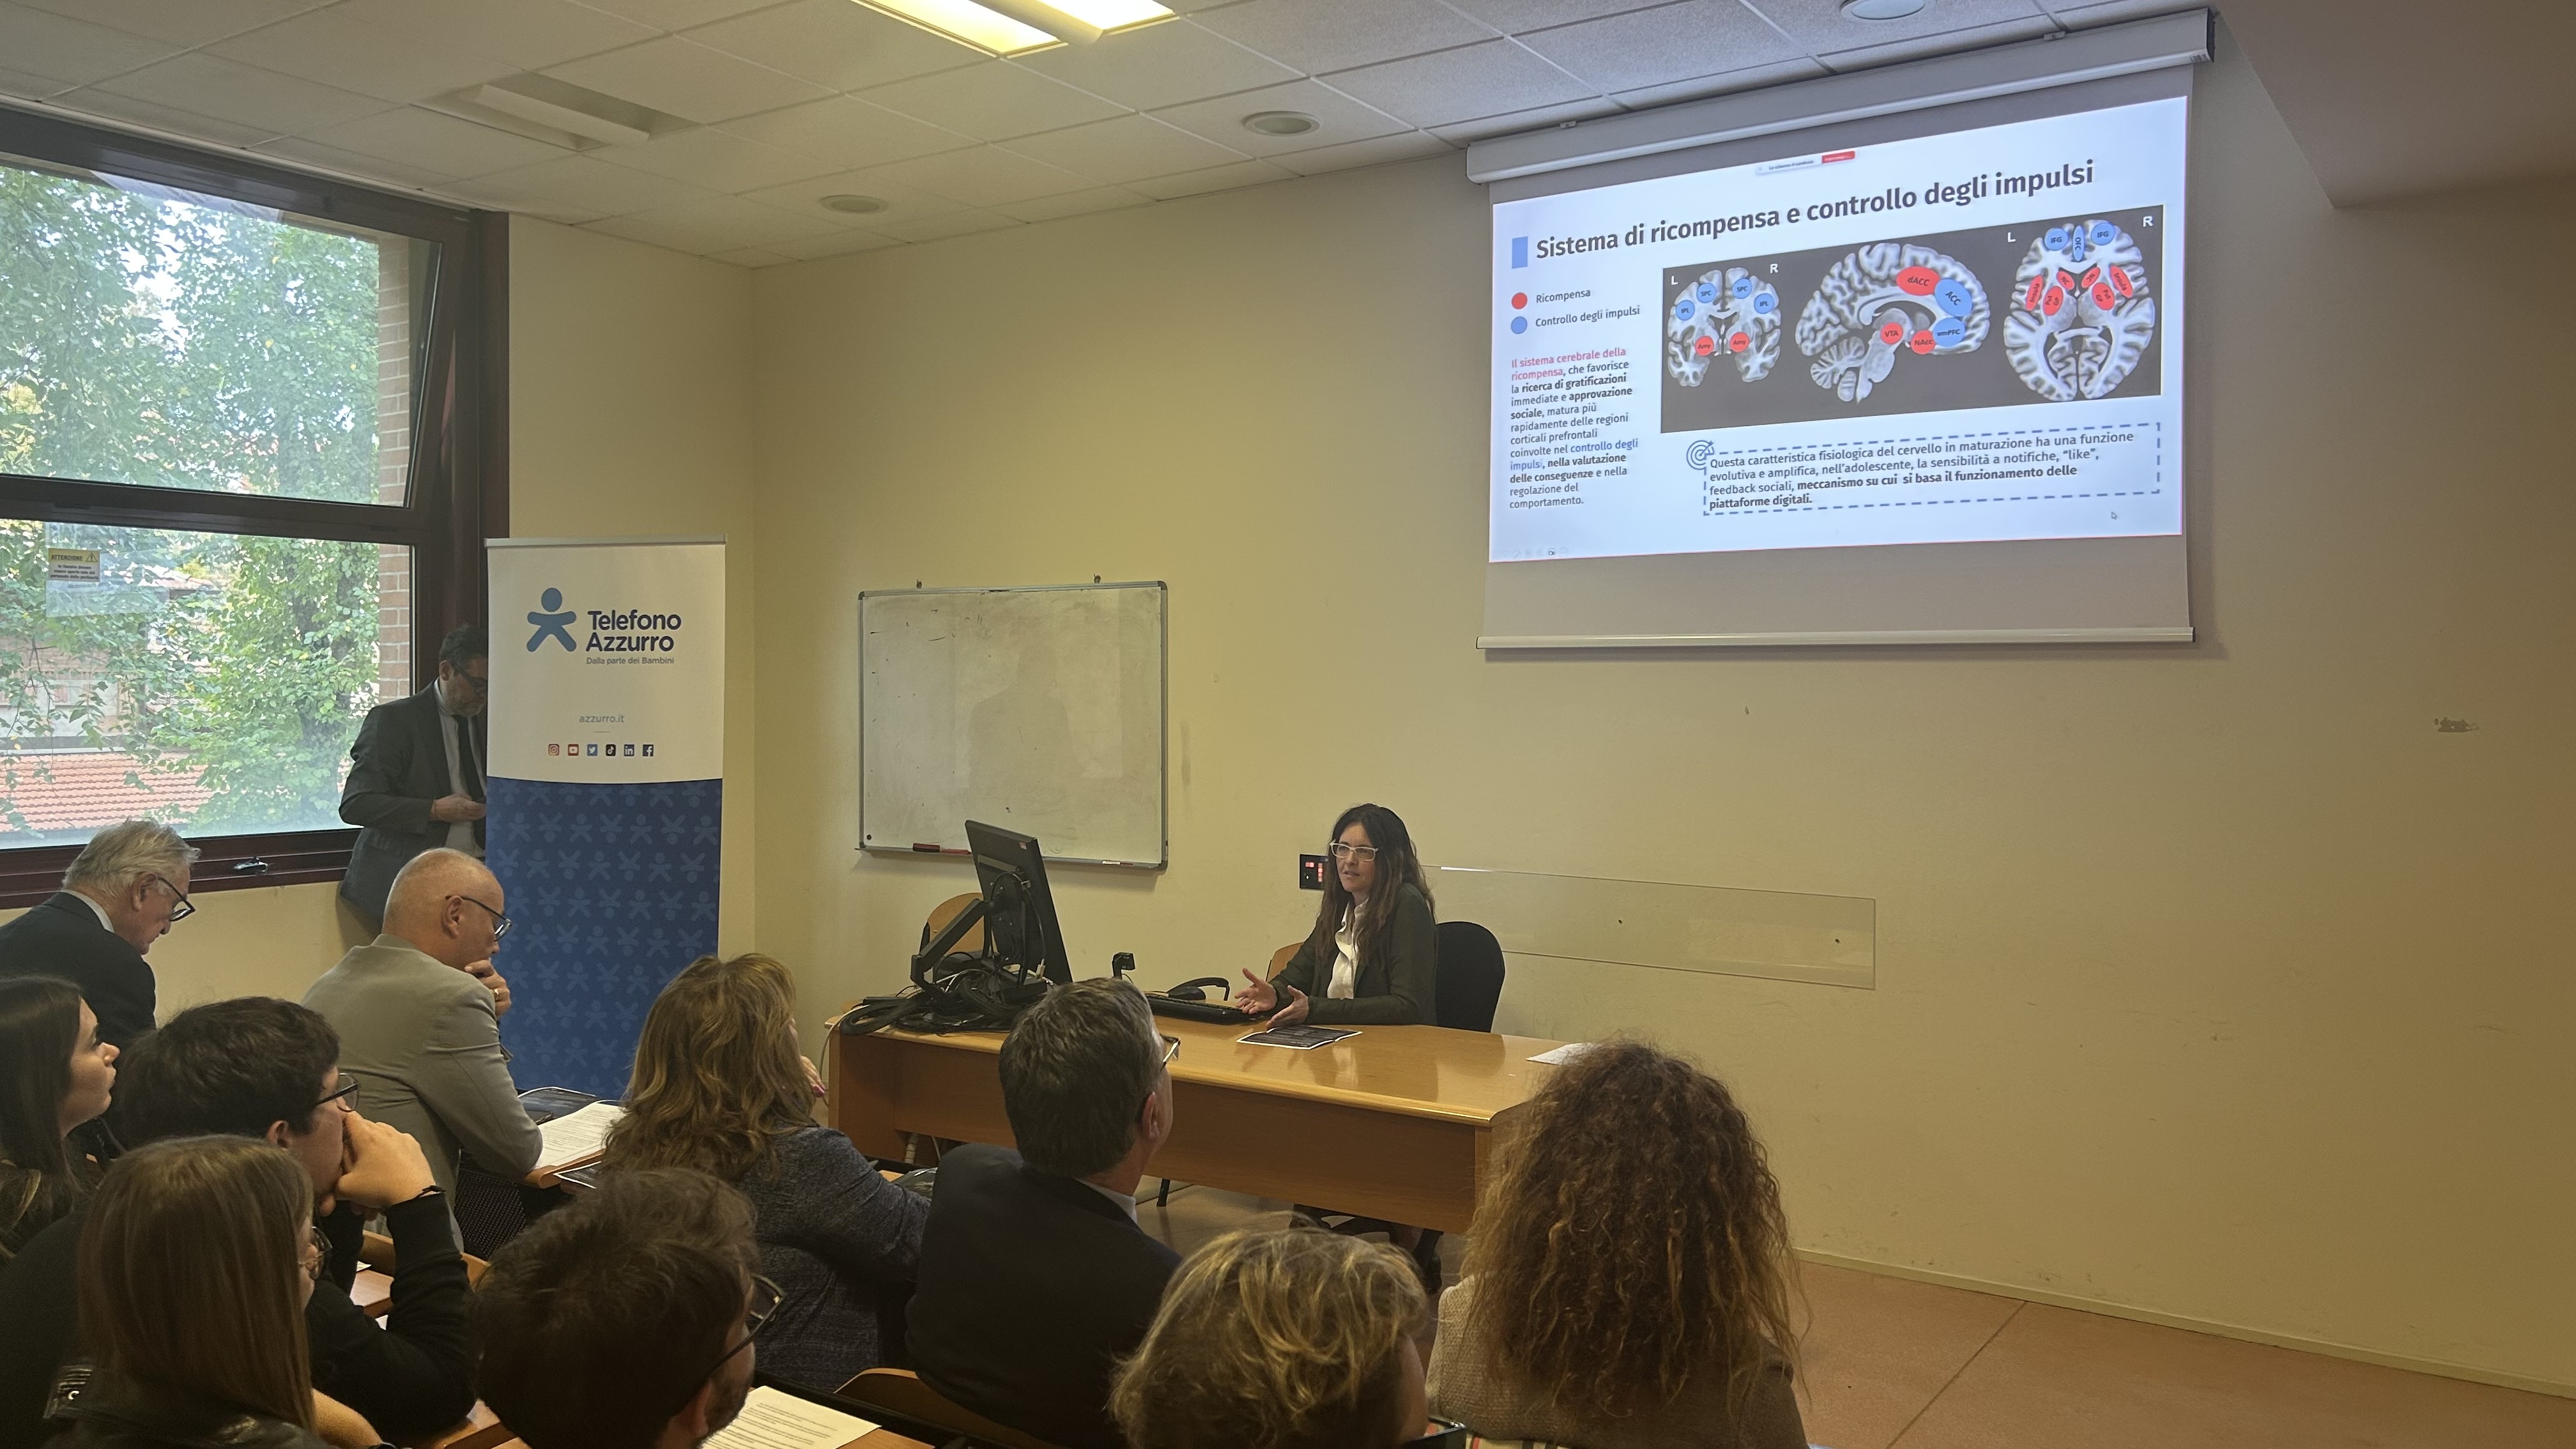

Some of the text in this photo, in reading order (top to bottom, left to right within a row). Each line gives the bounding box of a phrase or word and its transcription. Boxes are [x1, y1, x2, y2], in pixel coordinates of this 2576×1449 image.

[1537, 159, 2094, 259] Sistema di ricompensa e controllo degli impulsi
[2143, 216, 2153, 227] R
[2007, 232, 2016, 243] L
[1770, 263, 1779, 273] R
[1671, 276, 1678, 285] L
[1908, 277, 1929, 286] dACC
[1536, 288, 1591, 304] Ricompensa
[1945, 291, 1961, 306] ACC
[1535, 305, 1640, 328] Controllo degli impulsi
[1520, 355, 1554, 367] sistema
[1557, 351, 1600, 362] cerebrale
[1603, 348, 1626, 357] della
[1512, 361, 1629, 381] ricompensa, che favorisce
[1512, 372, 1626, 394] la ricerca di gratificazioni
[1511, 394, 1559, 406] immediate
[1569, 387, 1632, 402] approvazione
[1511, 403, 1597, 419] sociale, matura più
[1511, 413, 1629, 433] rapidamente delle regioni
[1511, 429, 1597, 445] corticali prefrontali
[1510, 438, 1638, 457] coinvolte nel controllo degli
[1710, 433, 2134, 468] Questa caratteristica fisiologica del cervello in maturazione ha una funzione
[1510, 453, 1626, 471] impulsi, nella valutazione
[1710, 470, 1756, 482] evolutiva
[1768, 466, 1818, 479] amplifica,
[1917, 459, 1927, 468] la
[1931, 454, 1989, 468] sensibilità
[1993, 456, 2000, 464] a
[2004, 451, 2059, 464] notifiche,
[1510, 473, 1532, 483] delle
[1535, 470, 1593, 482] conseguenze
[1604, 466, 1627, 476] nella
[1710, 465, 2077, 495] feedback sociali, meccanismo su cui si basa il funzionamento delle
[1510, 483, 1578, 498] regolazione del
[1510, 496, 1584, 509] comportamento.
[1710, 494, 1812, 510] piattaforme digitali.
[587, 610, 681, 631] Telefono
[585, 632, 674, 652] Azzurro
[579, 714, 624, 723] azzurro.it
